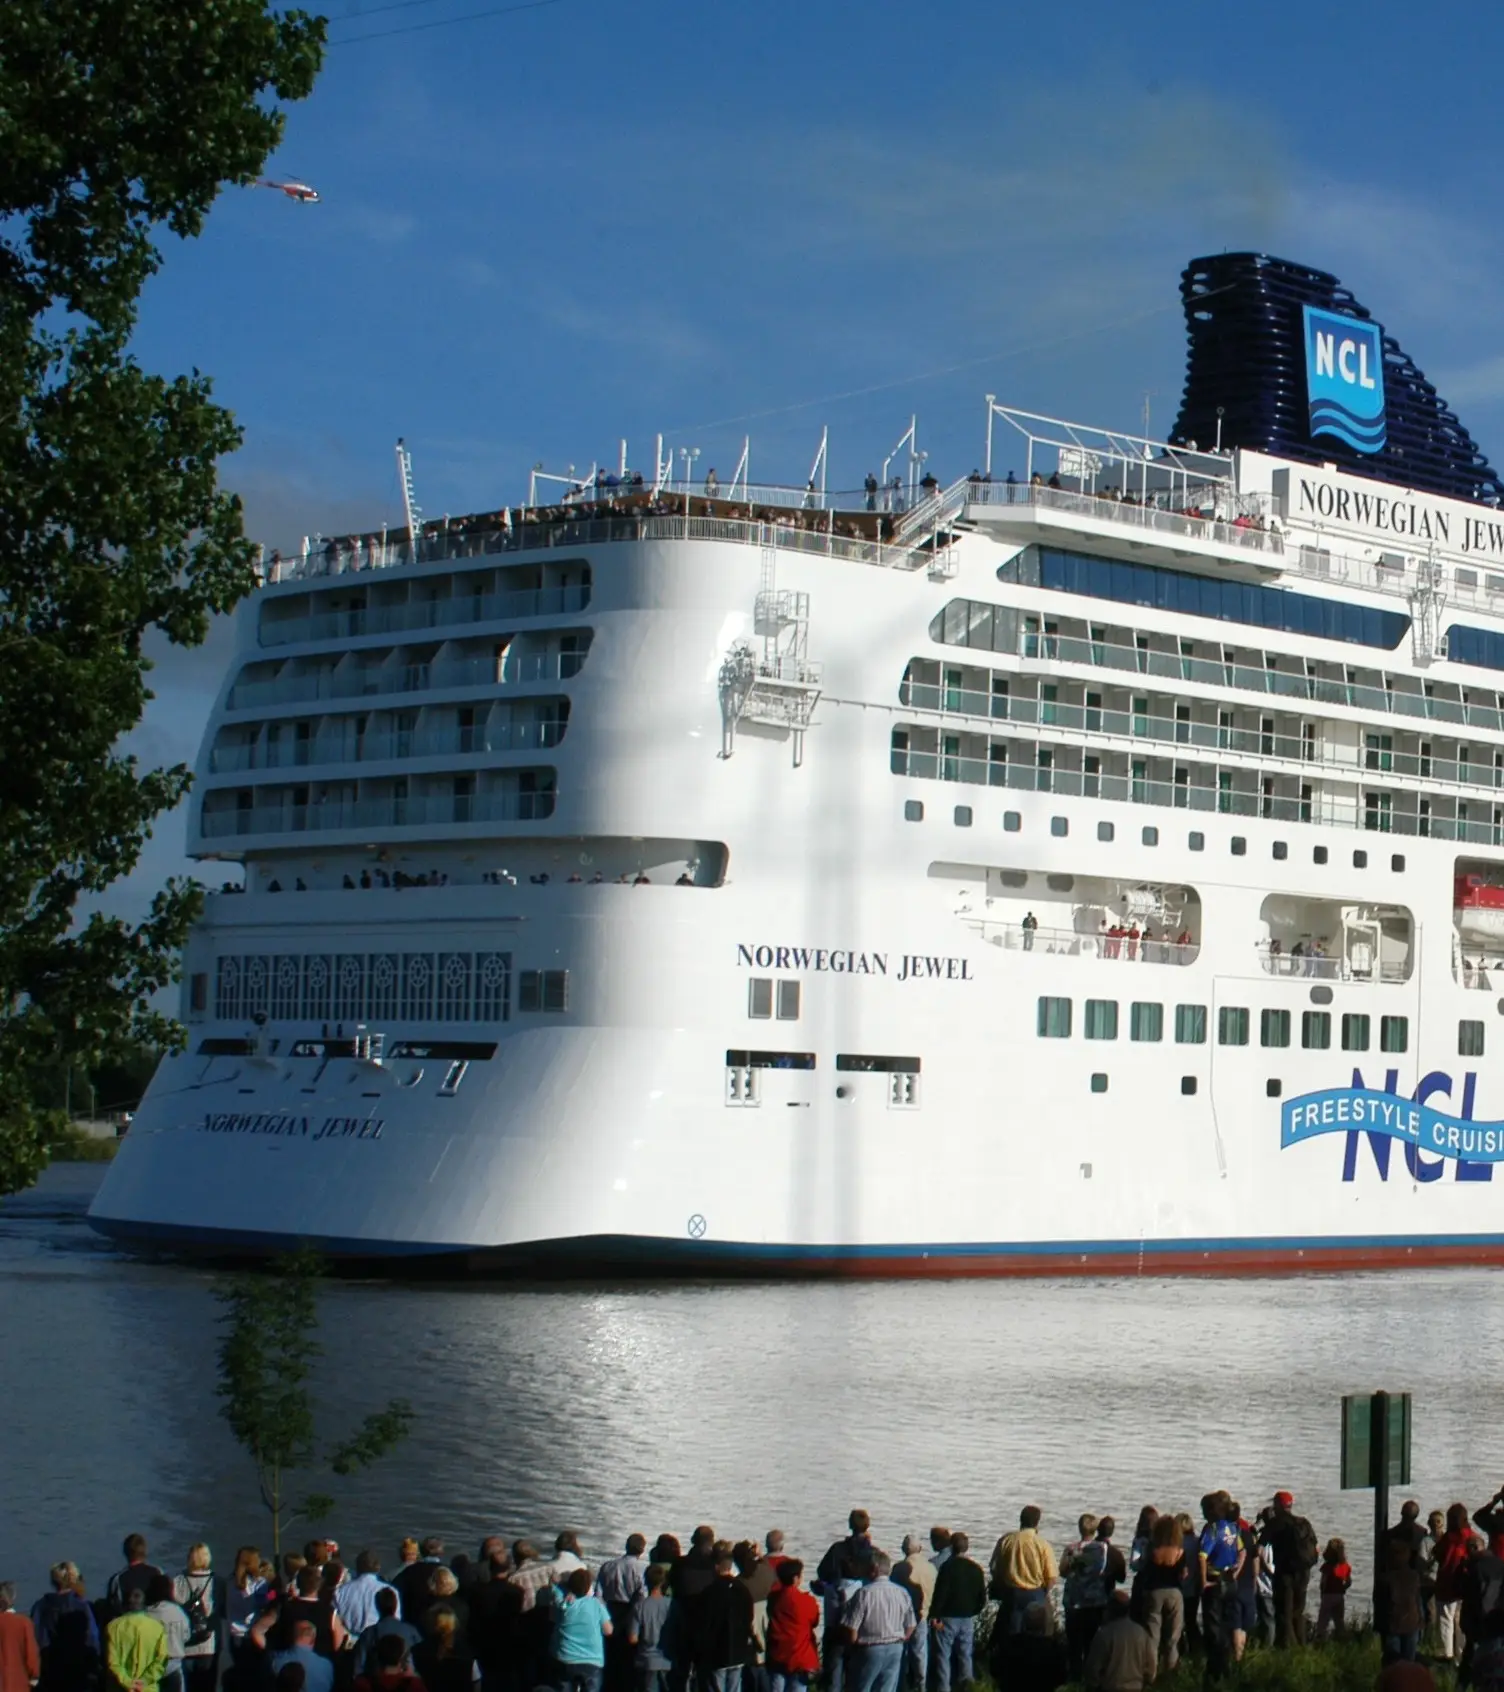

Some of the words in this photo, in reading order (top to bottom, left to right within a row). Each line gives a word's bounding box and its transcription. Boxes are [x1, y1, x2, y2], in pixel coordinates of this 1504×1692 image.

[1316, 330, 1376, 390] NCL
[1299, 478, 1451, 543] NORWEGIAN
[736, 943, 889, 976] NORWEGIAN
[897, 954, 974, 982] JEWEL
[197, 1112, 316, 1137] NORWEGIAN
[312, 1116, 386, 1142] JEWEL
[1290, 1097, 1420, 1137] FREESTYLE
[1342, 1067, 1494, 1183] NCL
